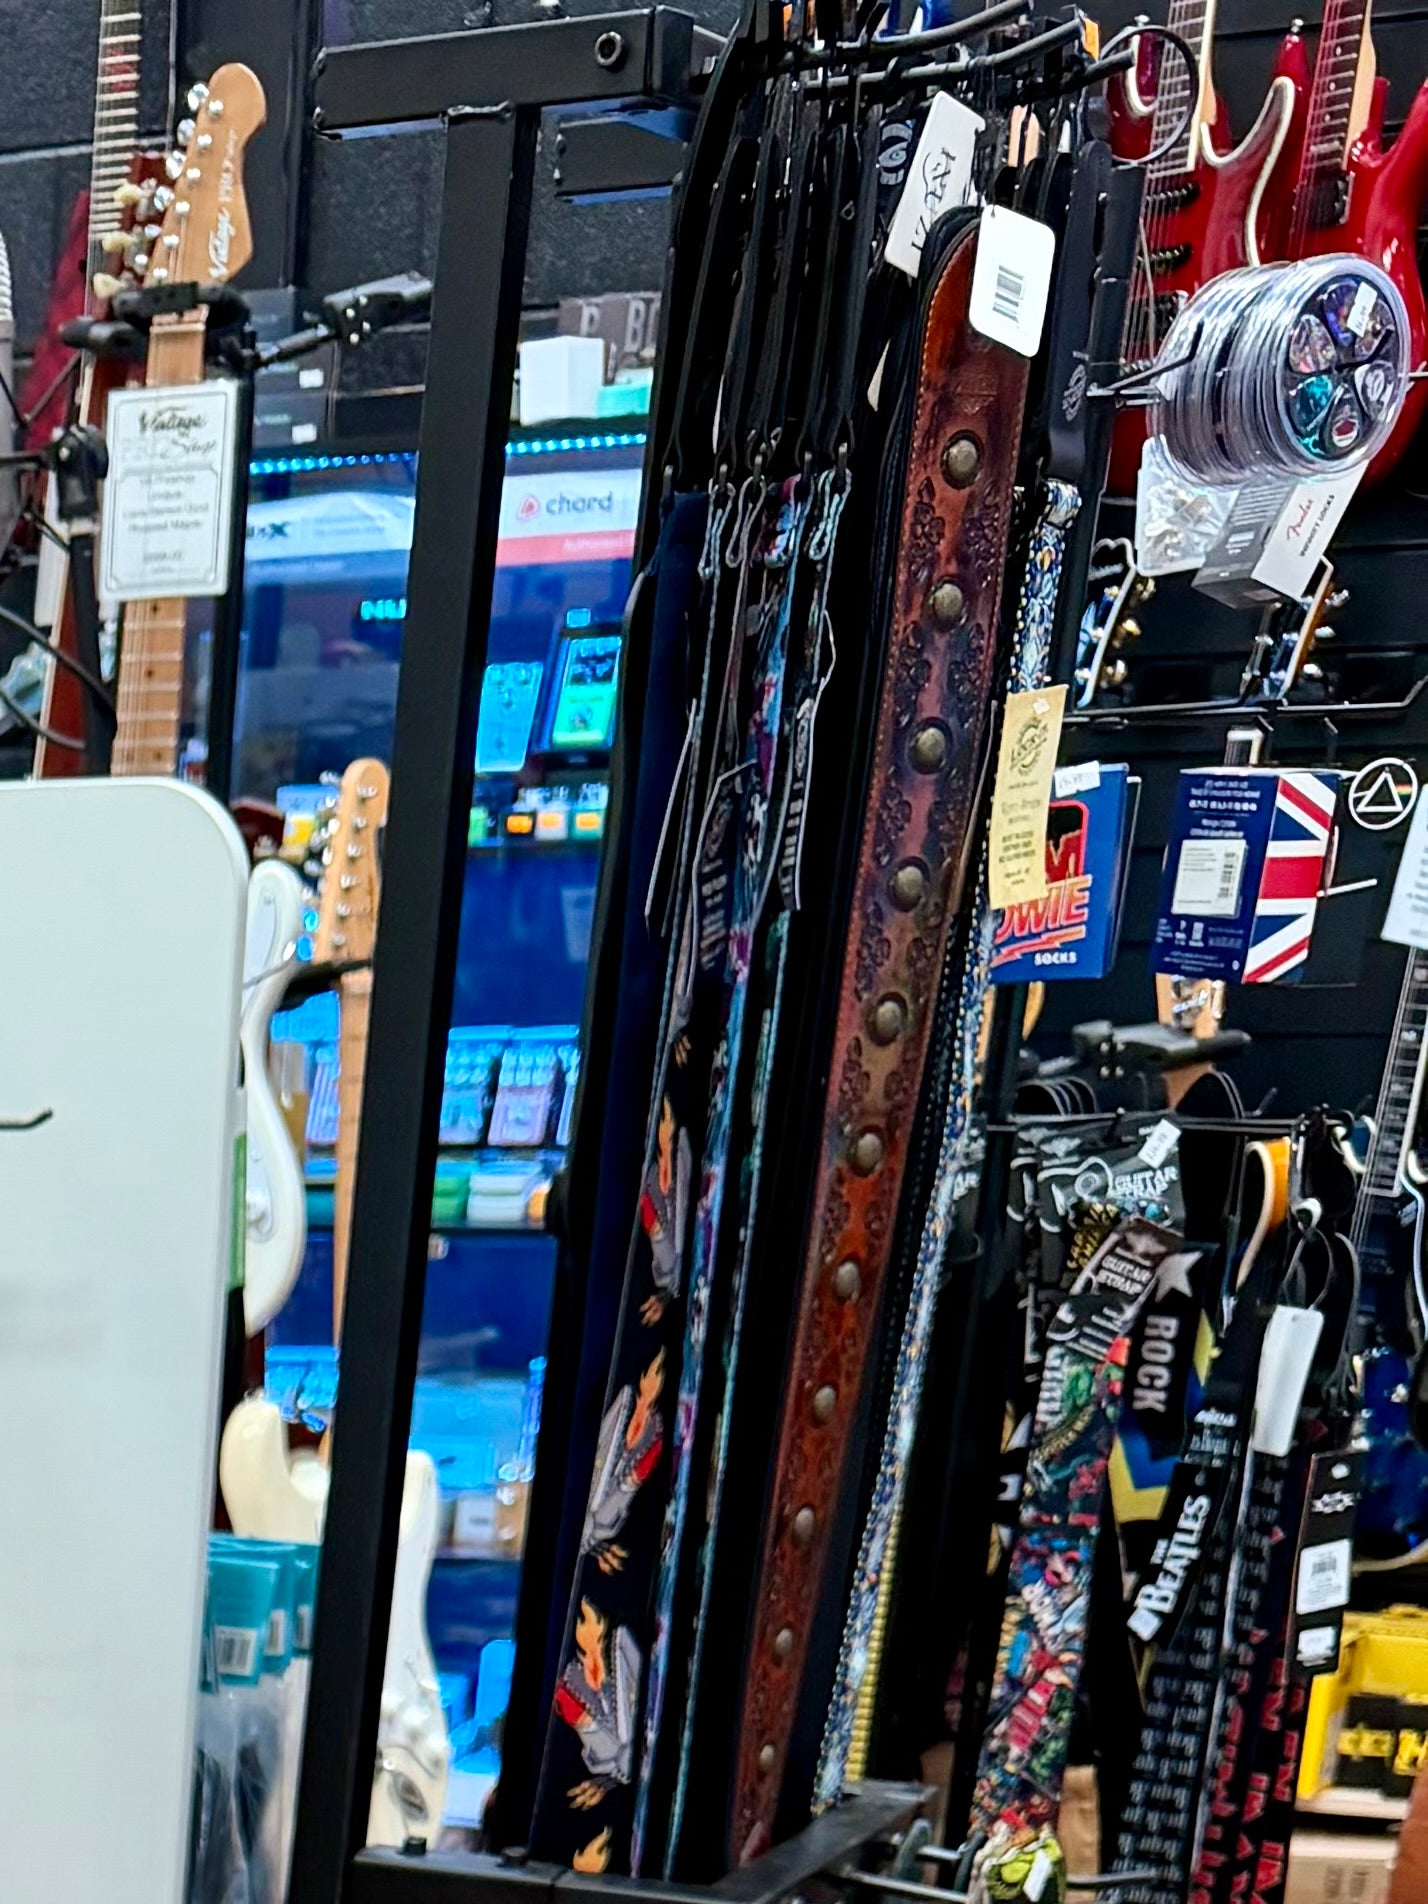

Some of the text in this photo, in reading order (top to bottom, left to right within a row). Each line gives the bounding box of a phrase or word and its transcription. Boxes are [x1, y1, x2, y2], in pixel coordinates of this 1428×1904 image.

[545, 487, 614, 518] chord
[995, 875, 1092, 945] OWIE
[1034, 951, 1078, 967] SOCKS
[1096, 1268, 1143, 1296] STRAP
[1101, 1254, 1153, 1284] GUITAR
[1133, 1313, 1179, 1414] ROCK
[1137, 1493, 1212, 1618] BEATLES
[1151, 1537, 1171, 1568] THE
